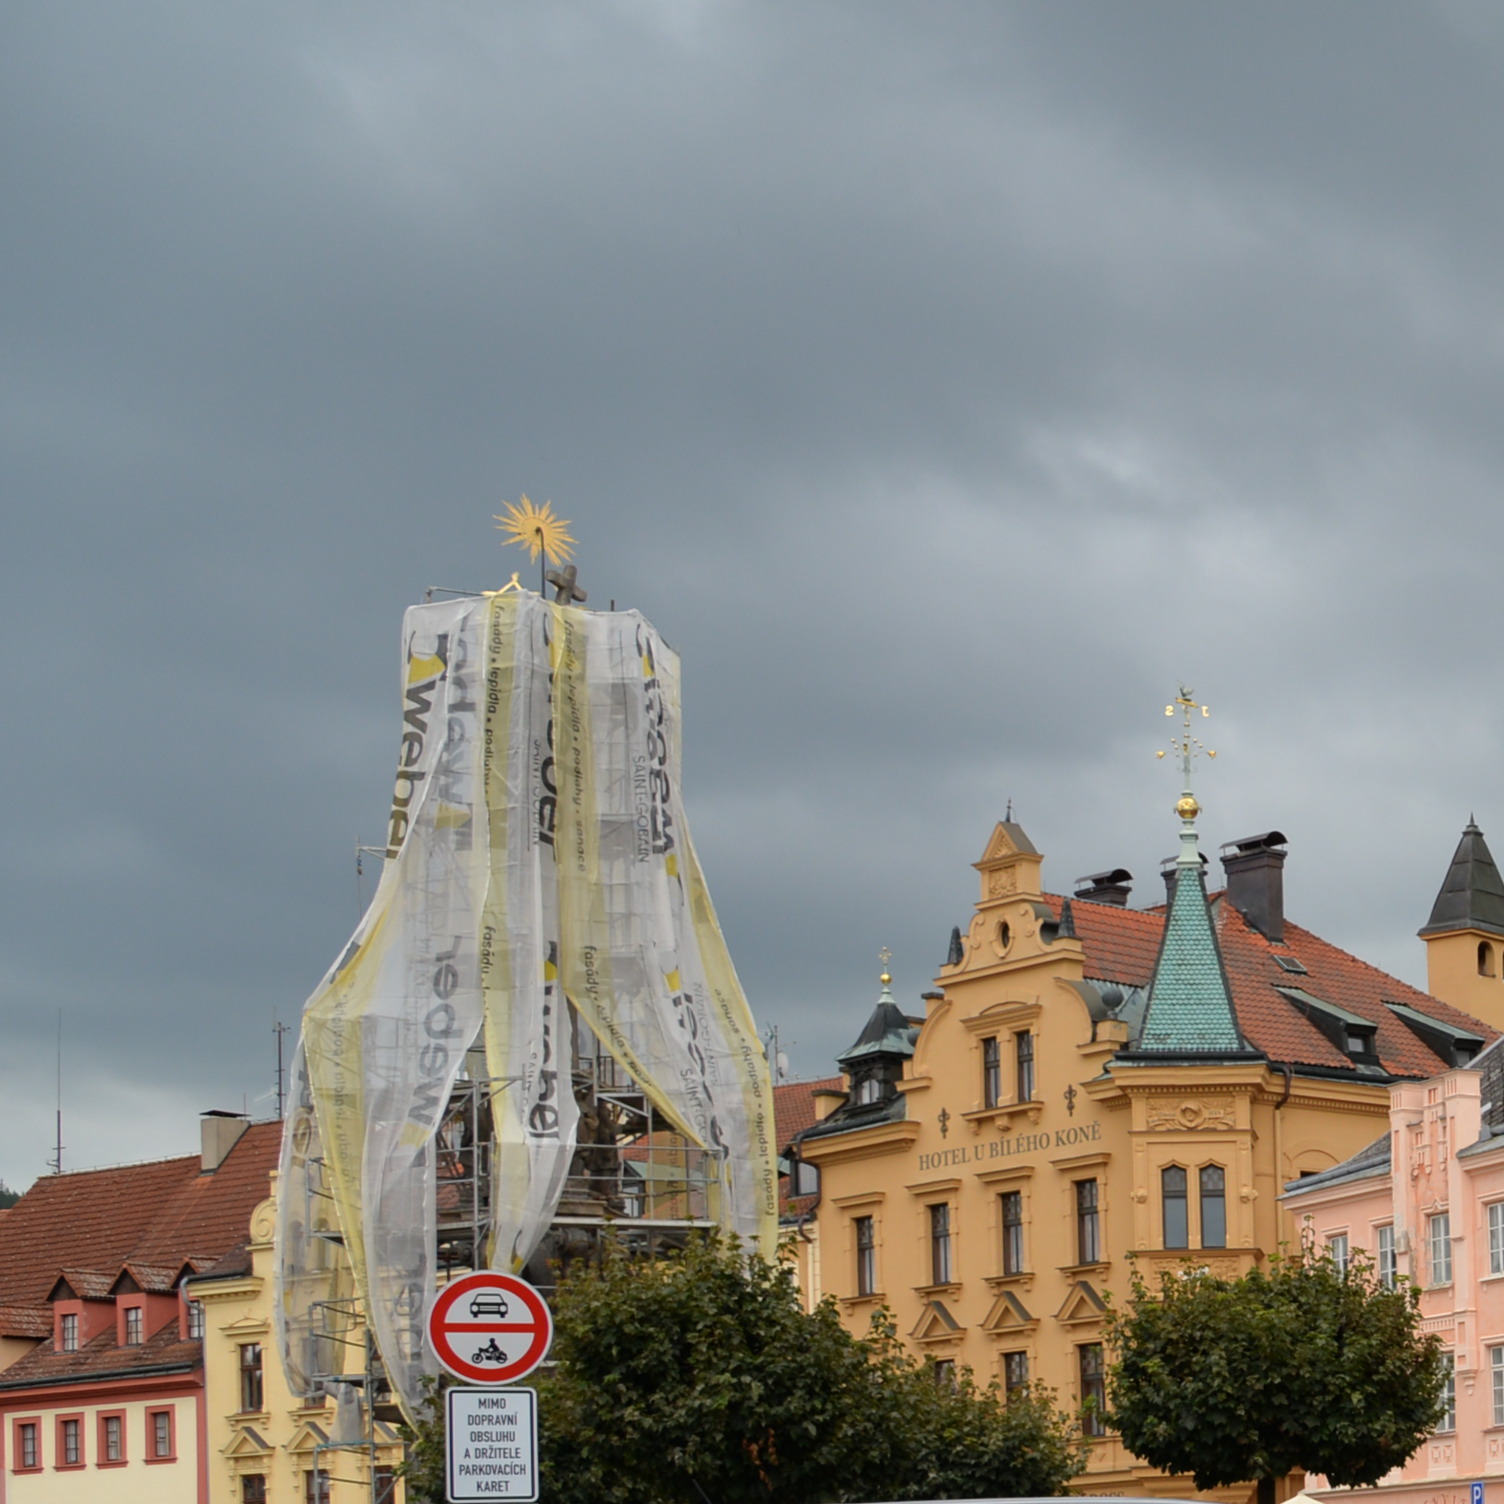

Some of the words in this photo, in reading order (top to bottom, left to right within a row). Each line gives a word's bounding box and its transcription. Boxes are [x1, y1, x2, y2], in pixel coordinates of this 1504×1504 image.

[489, 605, 505, 654] fasády
[487, 667, 501, 714] lepidla
[572, 747, 584, 806] podlahy
[633, 756, 650, 864] SAINT-GOBAIN
[574, 820, 587, 873] sanace
[584, 946, 601, 998] fasády
[714, 988, 740, 1034] sanace
[740, 1044, 762, 1098] podlahy
[756, 1112, 769, 1157] lepidla
[918, 1148, 971, 1171] HOTEL
[974, 1144, 986, 1162] U
[989, 1131, 1052, 1160] BÍLÉHO
[1054, 1121, 1102, 1149] KONĚ
[763, 1169, 776, 1216] fasády
[467, 1412, 518, 1426] DOPRAVNÍ
[478, 1398, 507, 1410] MIMO
[464, 1448, 471, 1459] A
[474, 1445, 521, 1459] DRŽITELE
[469, 1431, 516, 1443] OBSLUHU
[459, 1461, 527, 1476] PARKOVACÍCH
[476, 1481, 510, 1493] KARET
